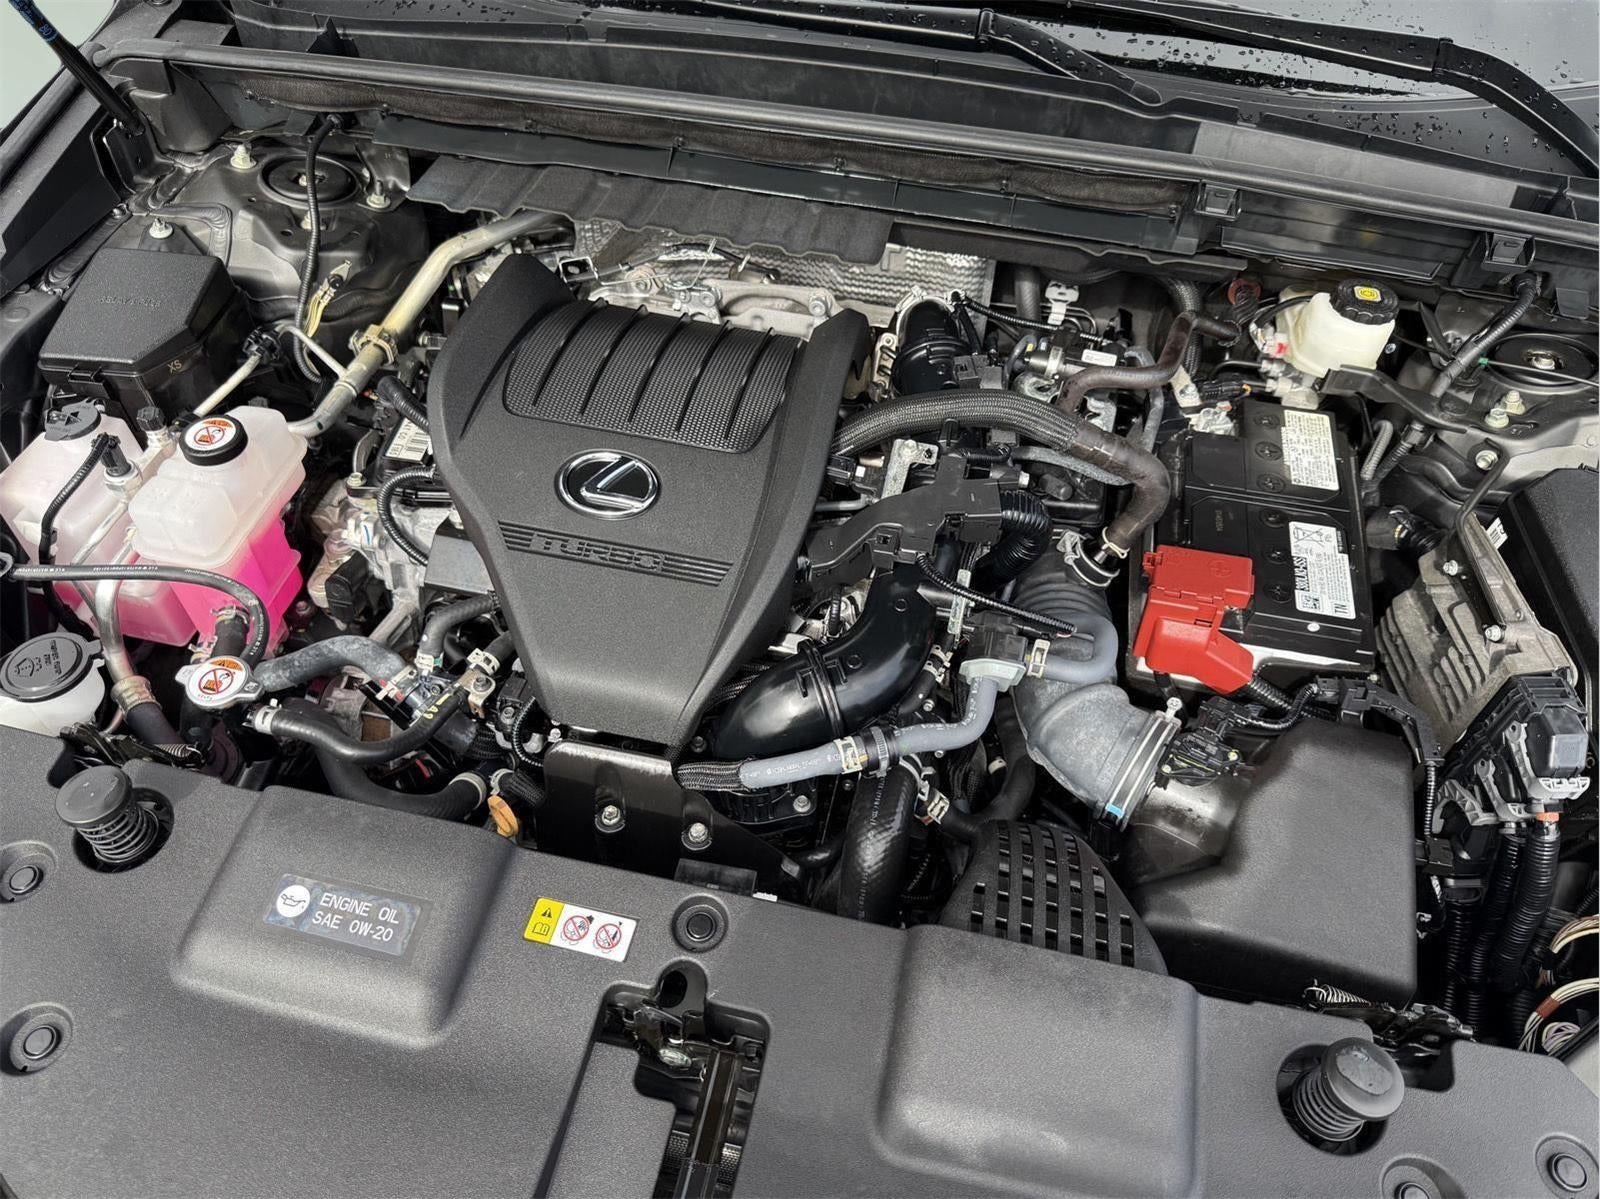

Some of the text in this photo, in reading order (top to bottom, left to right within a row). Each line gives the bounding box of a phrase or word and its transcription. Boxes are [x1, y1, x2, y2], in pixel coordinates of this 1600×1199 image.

[167, 359, 182, 374] XS
[535, 533, 665, 571] TURBO
[320, 892, 400, 924] ENGINE OIL
[312, 910, 394, 941] SAE 0W-20
